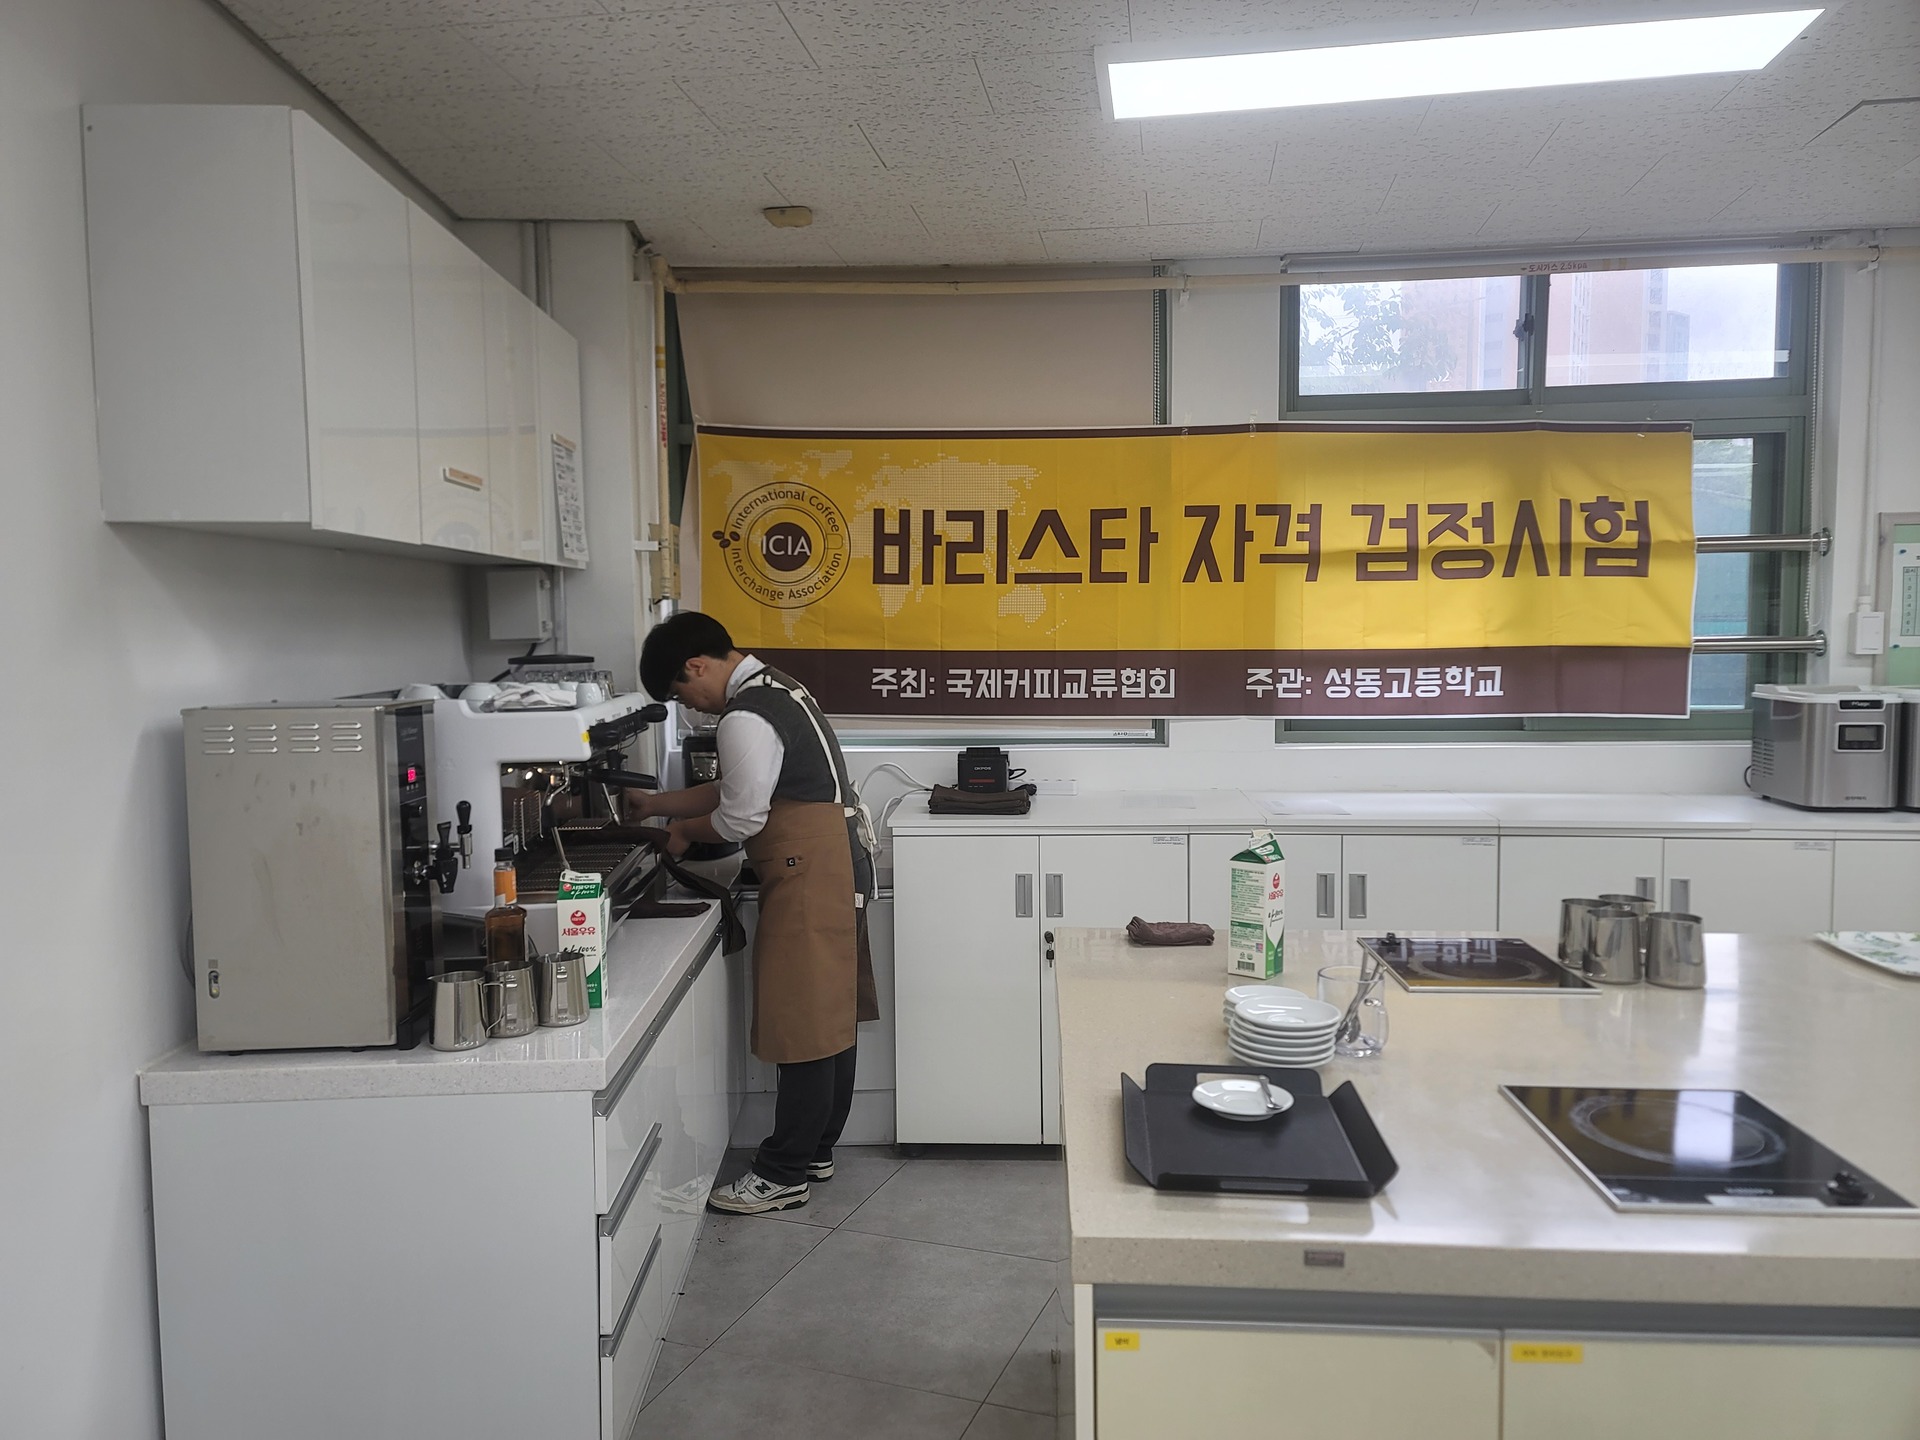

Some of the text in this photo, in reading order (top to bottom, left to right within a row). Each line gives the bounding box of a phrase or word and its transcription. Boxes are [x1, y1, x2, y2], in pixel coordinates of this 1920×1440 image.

[1528, 263, 1559, 273] 도시가스
[730, 489, 840, 534] International Coffee
[761, 535, 812, 557] ICIA
[872, 495, 1652, 586] 바리스타 자격 검정시험
[731, 547, 843, 602] Interchange Association
[870, 667, 1176, 700] 주최: 국제커피교류협회
[1245, 665, 1505, 700] 주관: 성동고등학교
[561, 927, 596, 937] 서울우유
